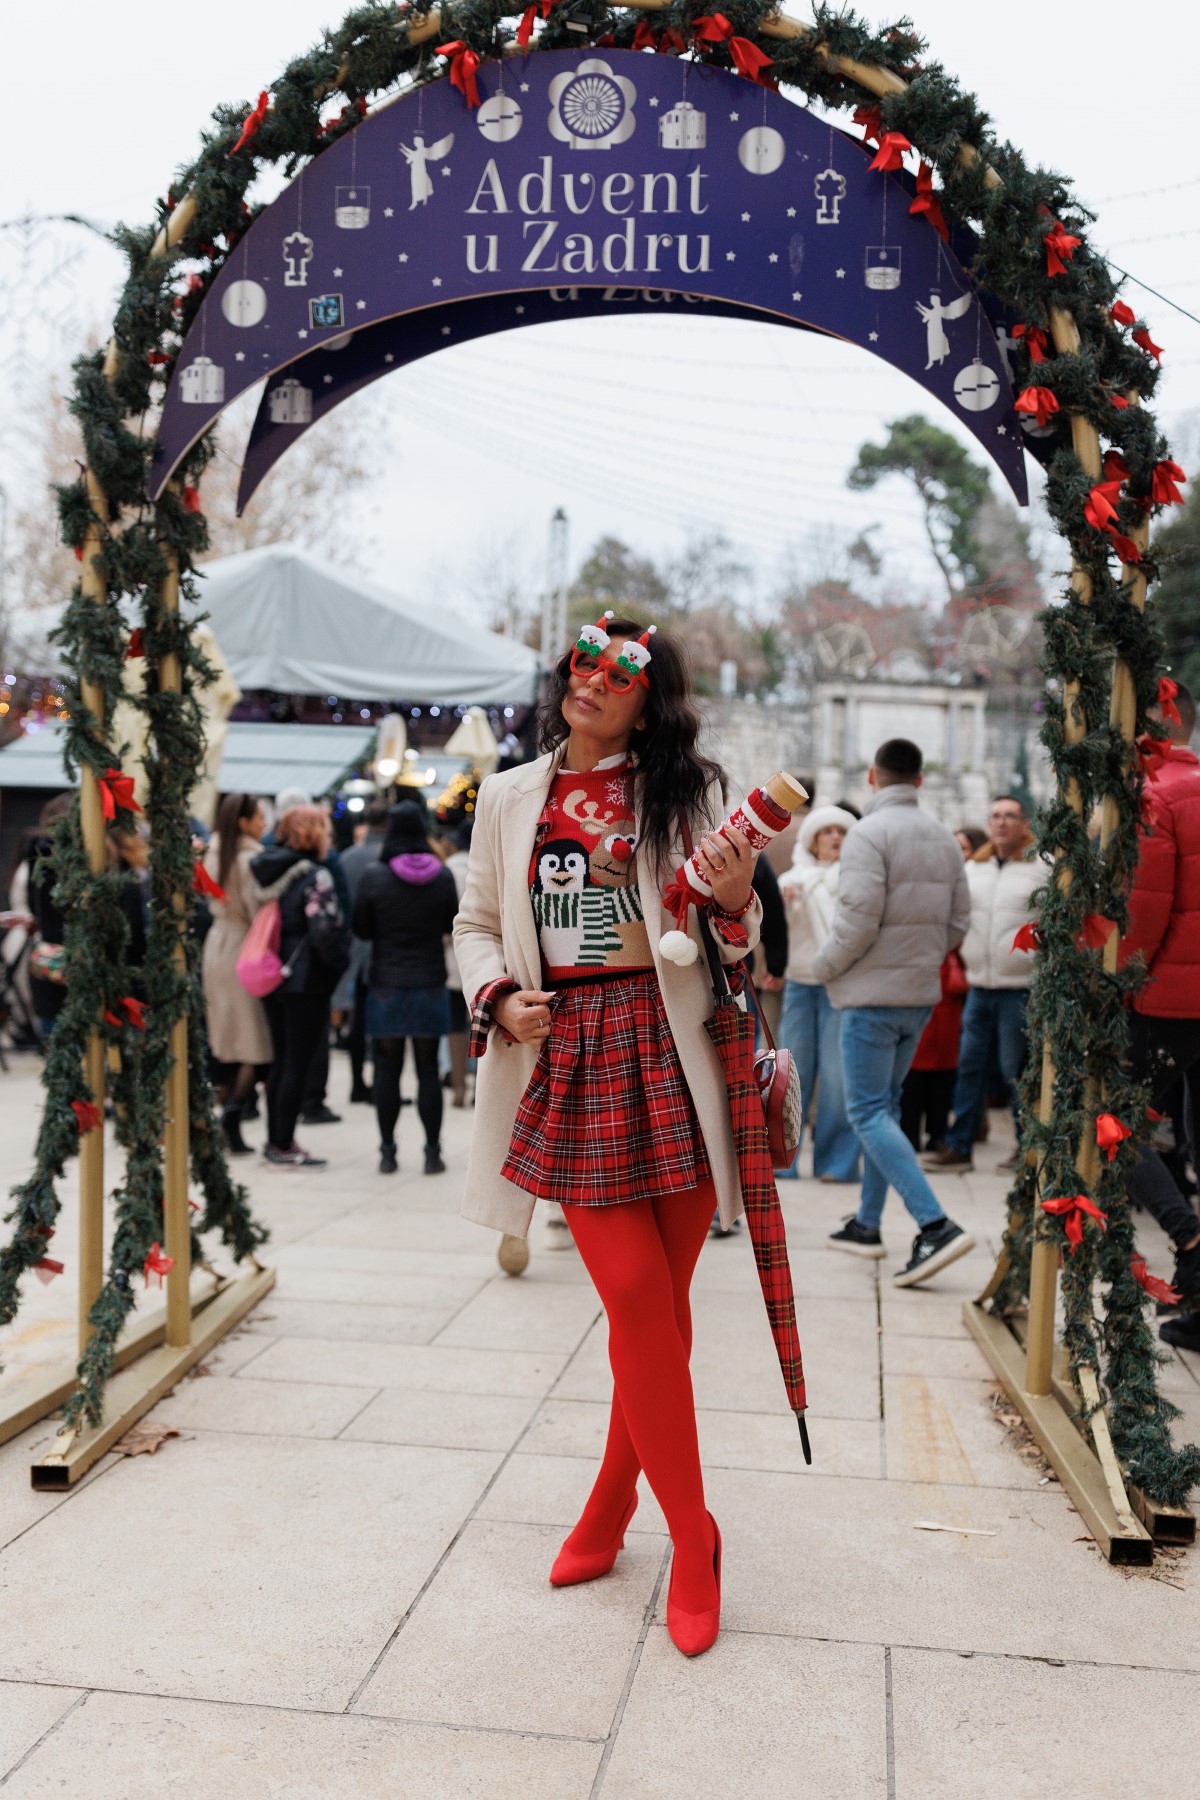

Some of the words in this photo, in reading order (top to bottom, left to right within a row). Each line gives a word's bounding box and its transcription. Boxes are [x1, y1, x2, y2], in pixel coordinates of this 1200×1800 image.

[464, 155, 710, 215] Advent
[463, 234, 502, 274] u
[520, 217, 715, 274] Zadru
